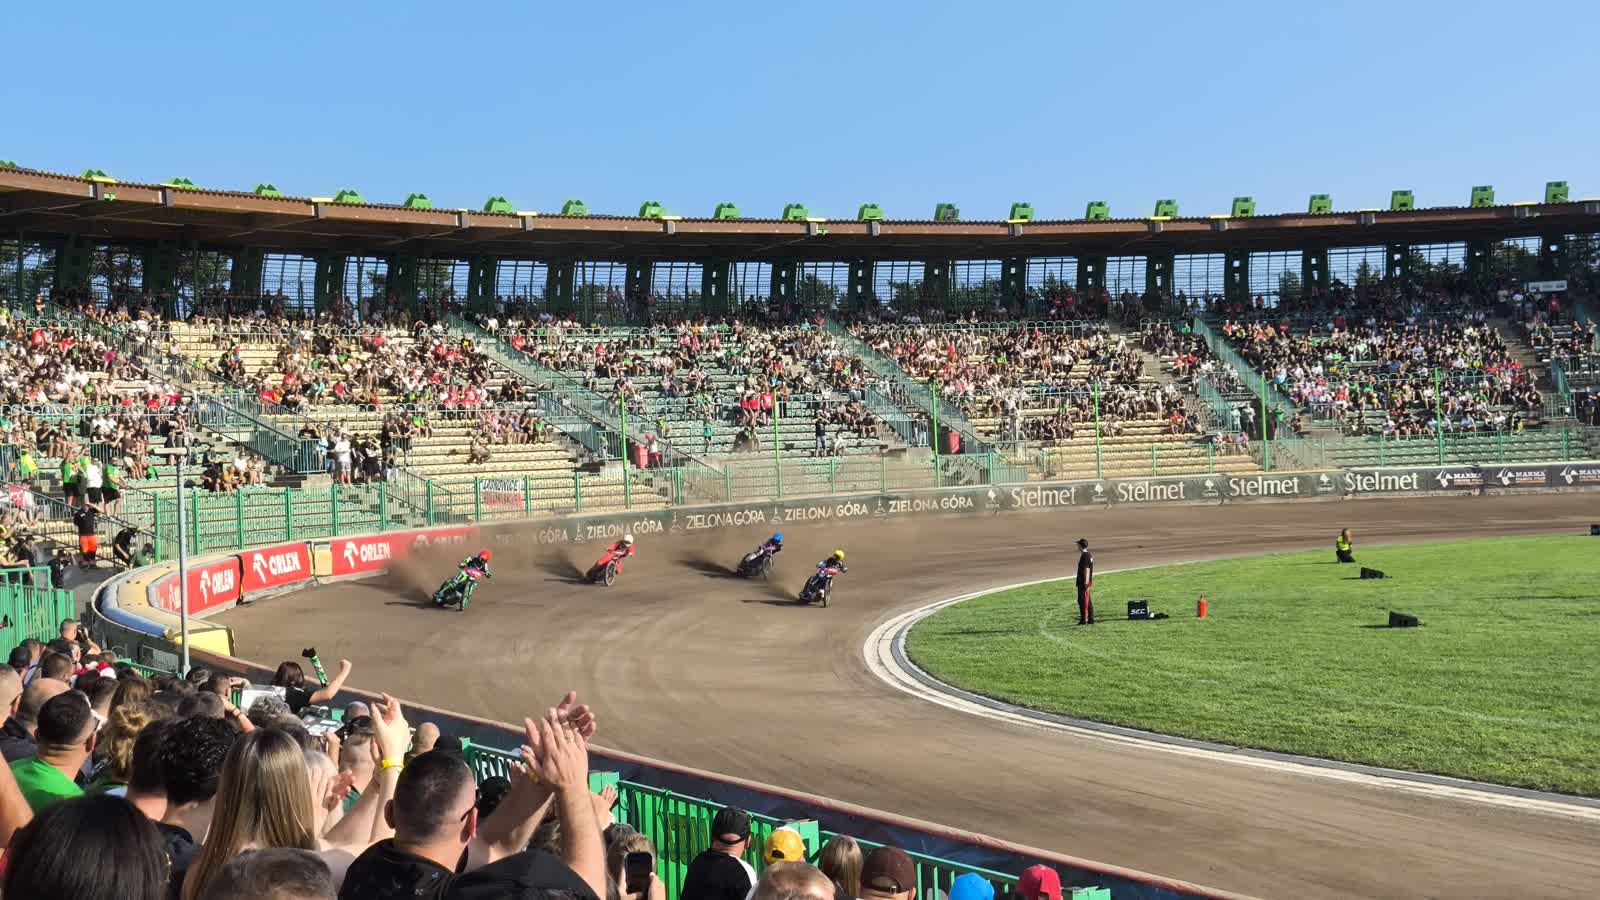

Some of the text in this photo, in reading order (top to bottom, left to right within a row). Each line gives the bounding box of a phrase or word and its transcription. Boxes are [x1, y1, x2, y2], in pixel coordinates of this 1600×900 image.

[1118, 481, 1185, 502] Stelmet
[1229, 476, 1300, 496] Stelmet
[1345, 472, 1419, 491] Stelmet
[888, 494, 974, 513] ZIELONA GÓRA
[1011, 486, 1076, 508] Stelmet
[686, 509, 765, 530] ZIELONA GÓRA
[784, 501, 868, 521] ZIELONA GÓRA
[539, 527, 568, 545] GÓRA
[587, 517, 663, 540] ZIELONA GÓRA
[360, 541, 391, 563] ORLEN
[269, 551, 301, 576] ORLEN
[212, 568, 234, 595] ORLEN
